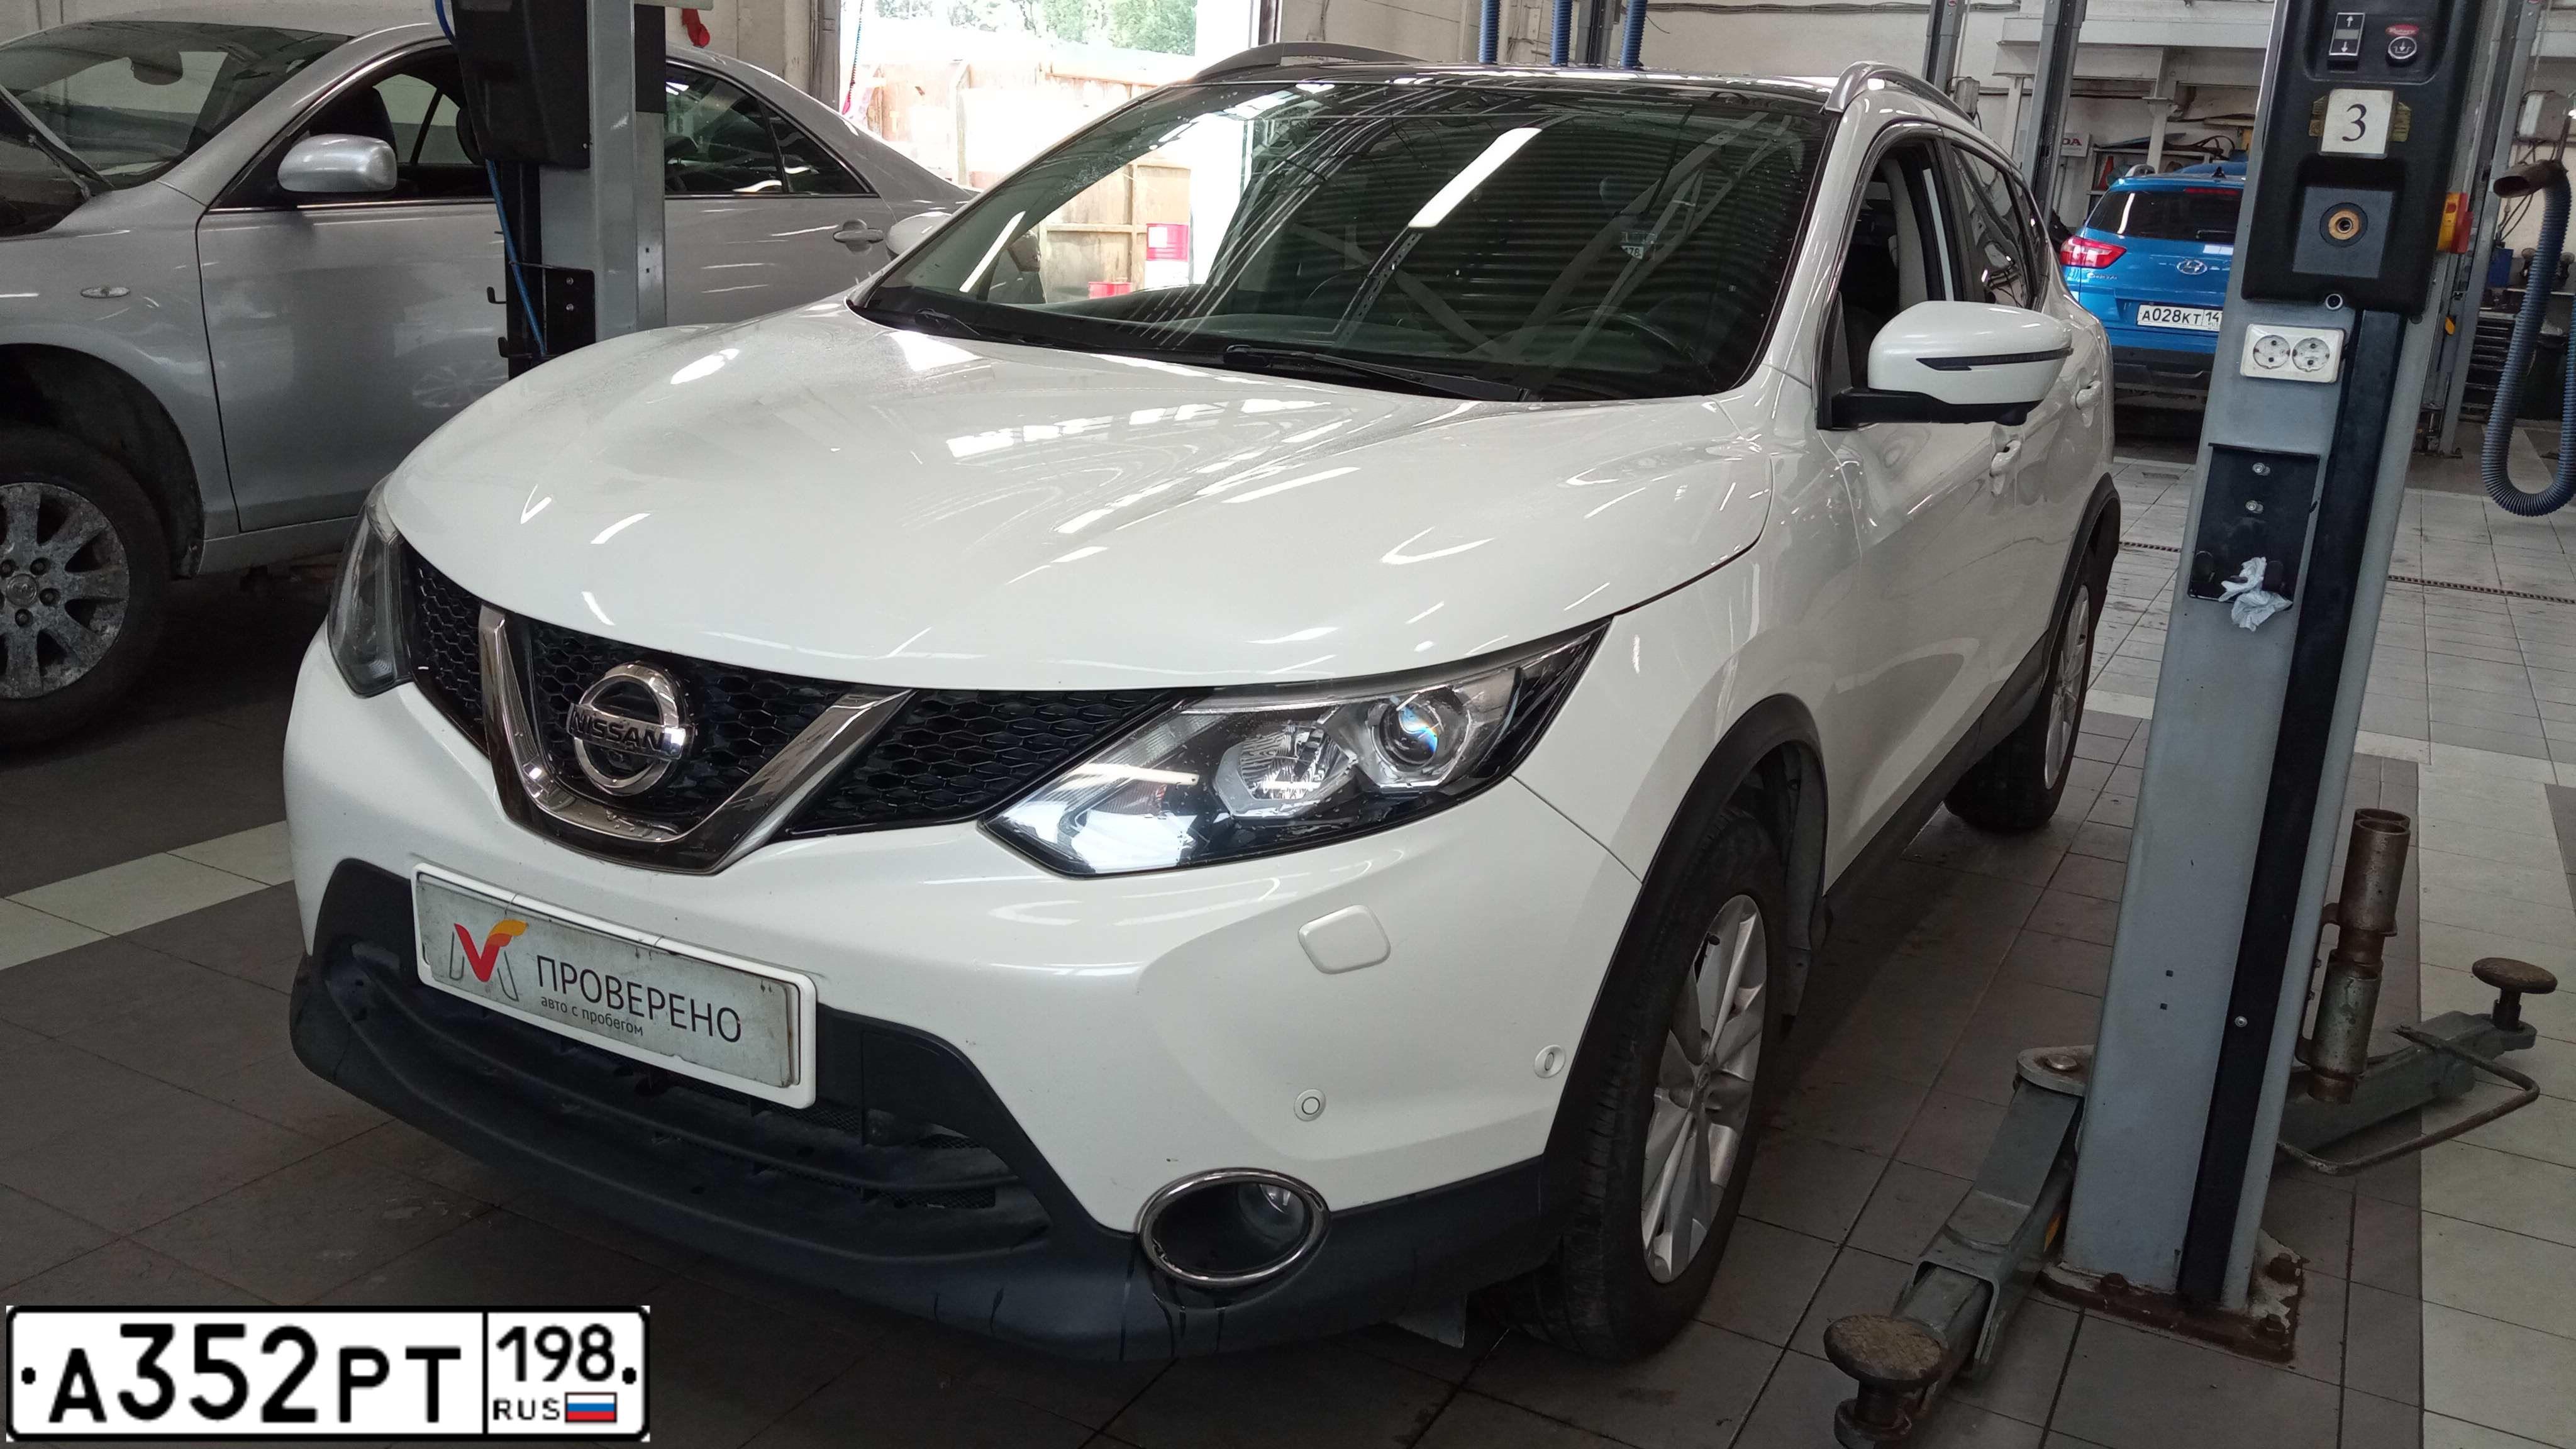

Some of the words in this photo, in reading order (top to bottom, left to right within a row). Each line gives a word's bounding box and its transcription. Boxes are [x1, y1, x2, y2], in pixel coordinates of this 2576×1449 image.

[2341, 103, 2367, 142] 3
[2206, 311, 2222, 323] 14
[571, 709, 667, 753] NISSAN
[536, 954, 741, 1043] ПРОВЕРЕНО
[541, 996, 568, 1013] авто
[572, 1006, 579, 1017] с
[582, 1009, 643, 1036] пробегом
